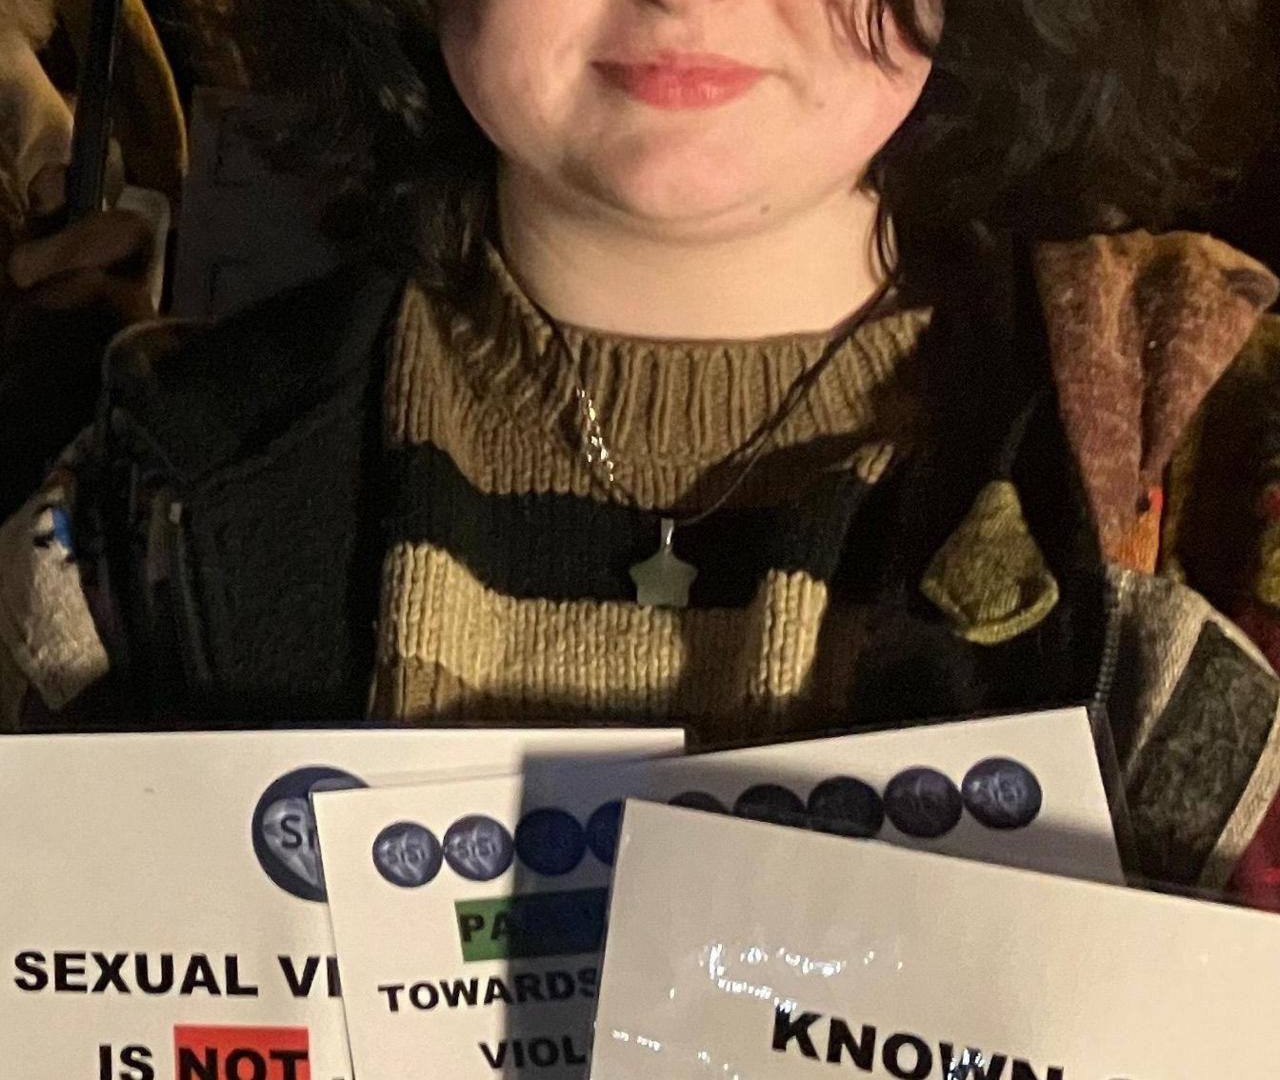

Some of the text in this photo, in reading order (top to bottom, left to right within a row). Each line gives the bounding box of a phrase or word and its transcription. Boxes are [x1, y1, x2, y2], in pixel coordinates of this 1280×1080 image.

[14, 951, 258, 997] SEXUAL
[378, 966, 598, 1014] TOWARDS
[98, 1043, 309, 1080] IS NOT
